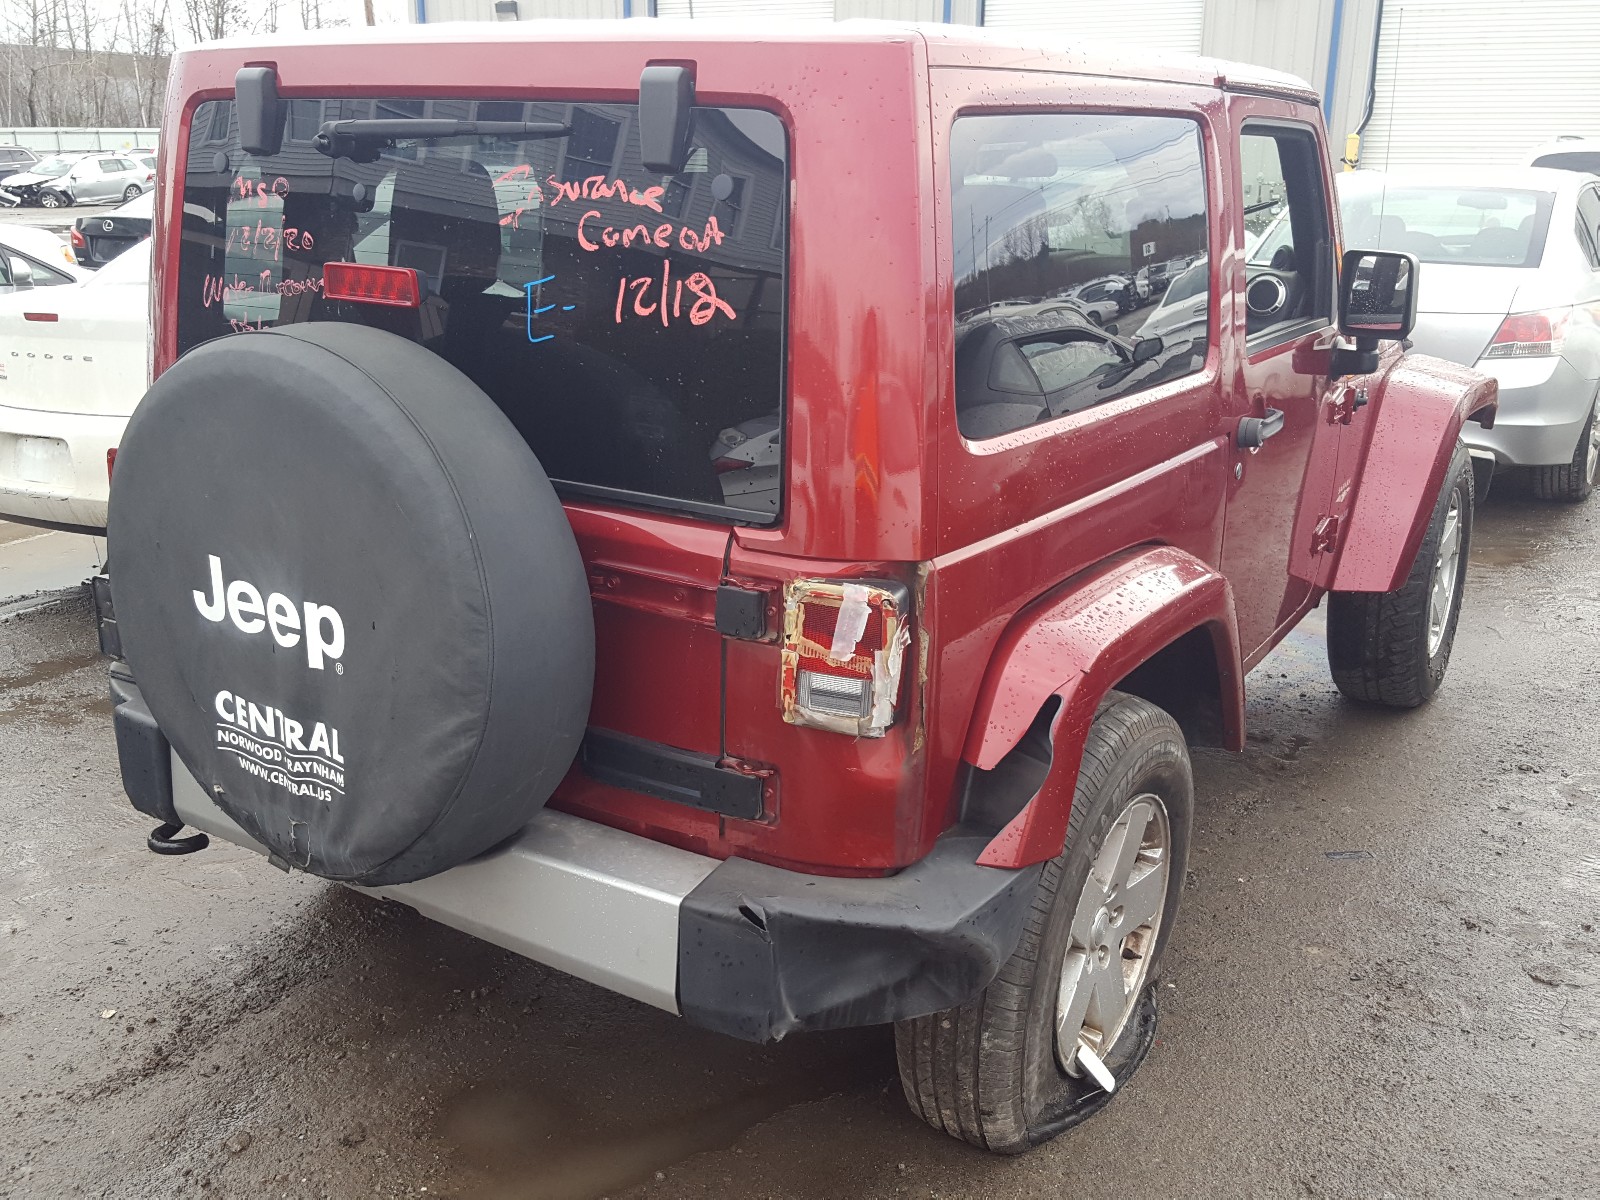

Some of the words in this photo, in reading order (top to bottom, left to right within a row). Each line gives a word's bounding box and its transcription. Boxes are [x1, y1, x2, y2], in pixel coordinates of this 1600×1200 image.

[11, 351, 93, 362] DODGE
[193, 553, 345, 670] Jeep
[215, 690, 345, 764] CENTRAL
[217, 729, 283, 761] NORWOOD
[238, 756, 332, 801] WWW.CENTRAL.US
